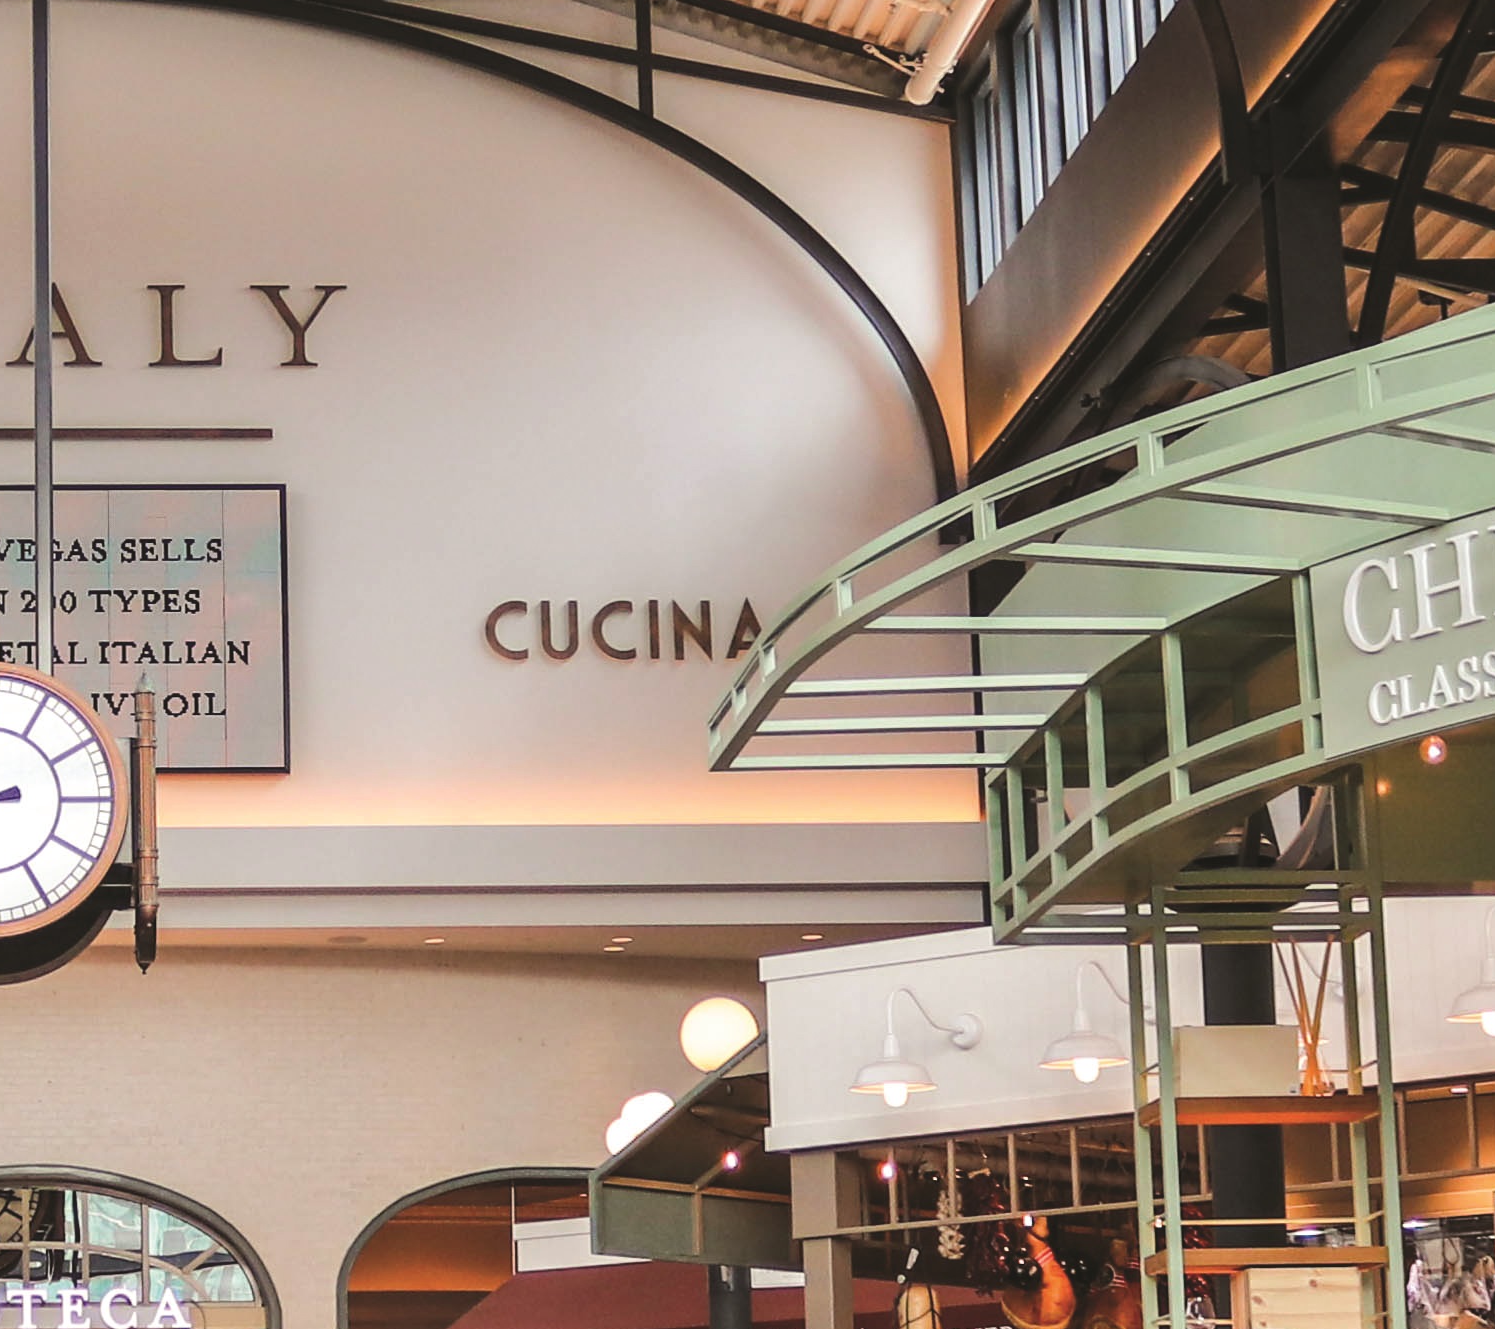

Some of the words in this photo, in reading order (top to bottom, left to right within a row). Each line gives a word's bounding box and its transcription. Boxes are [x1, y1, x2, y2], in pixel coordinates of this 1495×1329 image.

[120, 538, 223, 563] SELLS
[20, 589, 78, 614] 20
[88, 589, 201, 614] TYPES
[485, 598, 762, 661] CUCINA
[98, 641, 251, 666] ITALIAN
[163, 692, 226, 717] OIL
